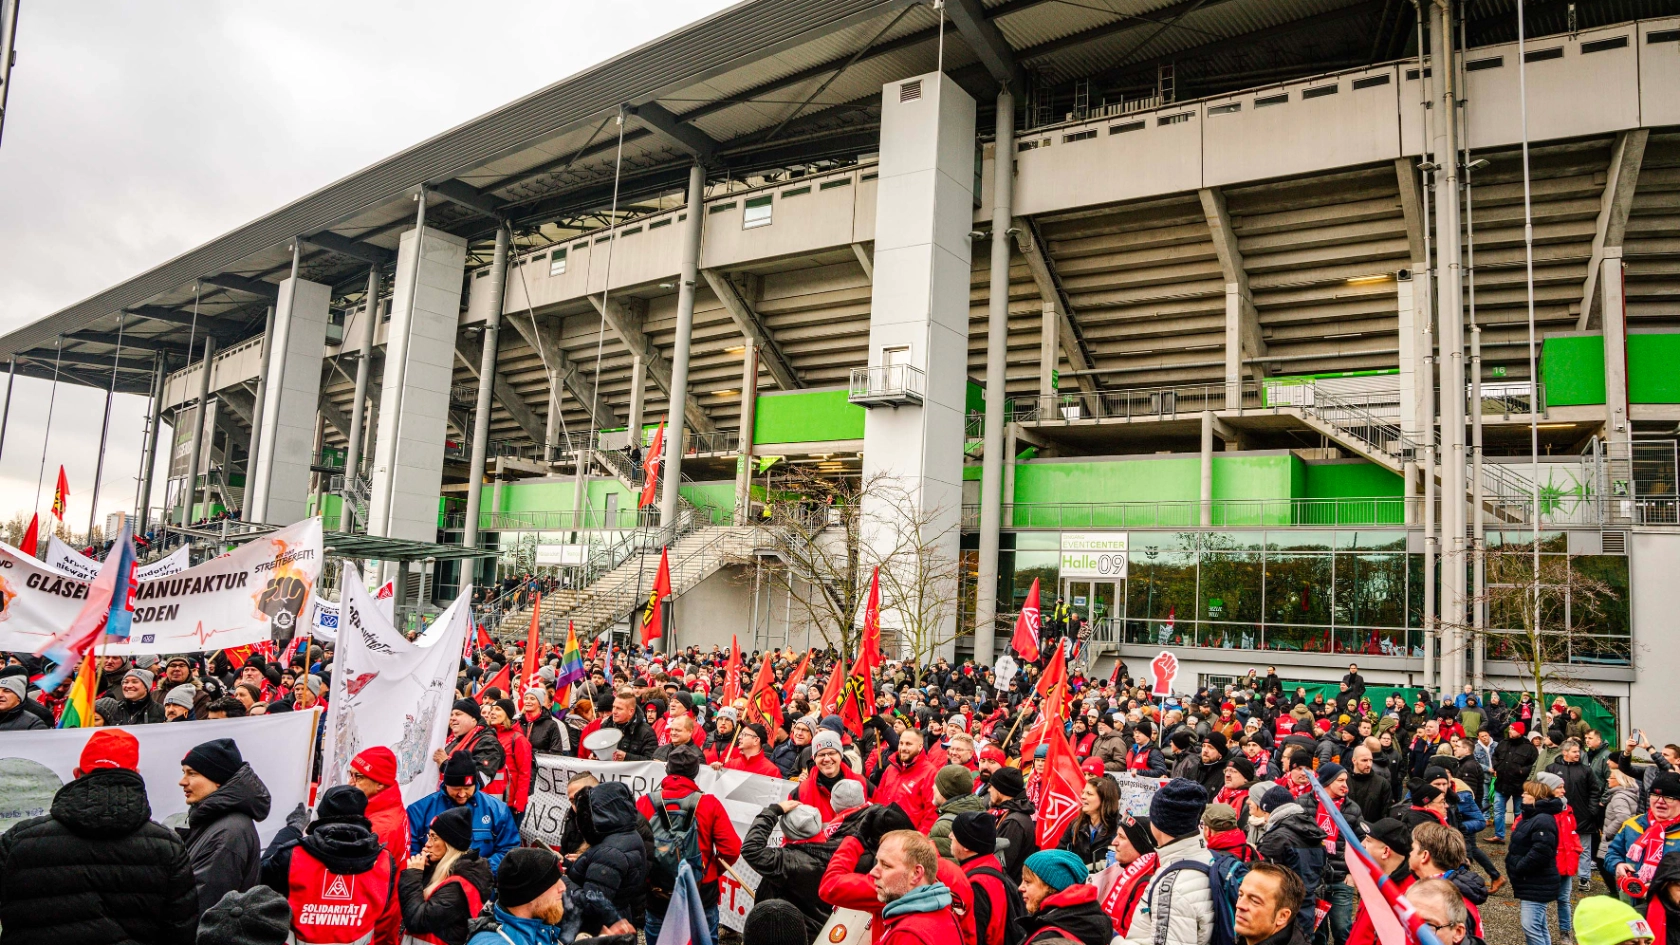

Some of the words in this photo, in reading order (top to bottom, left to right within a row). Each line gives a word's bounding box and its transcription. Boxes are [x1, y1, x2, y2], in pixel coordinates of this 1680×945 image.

[1063, 541, 1125, 549] EVENTCENTER
[255, 549, 315, 573] STREITBEREIT!
[1062, 554, 1097, 569] Halle
[1098, 554, 1125, 575] 09
[132, 604, 179, 624] SDEN
[302, 903, 360, 915] SOLIDARITÄT
